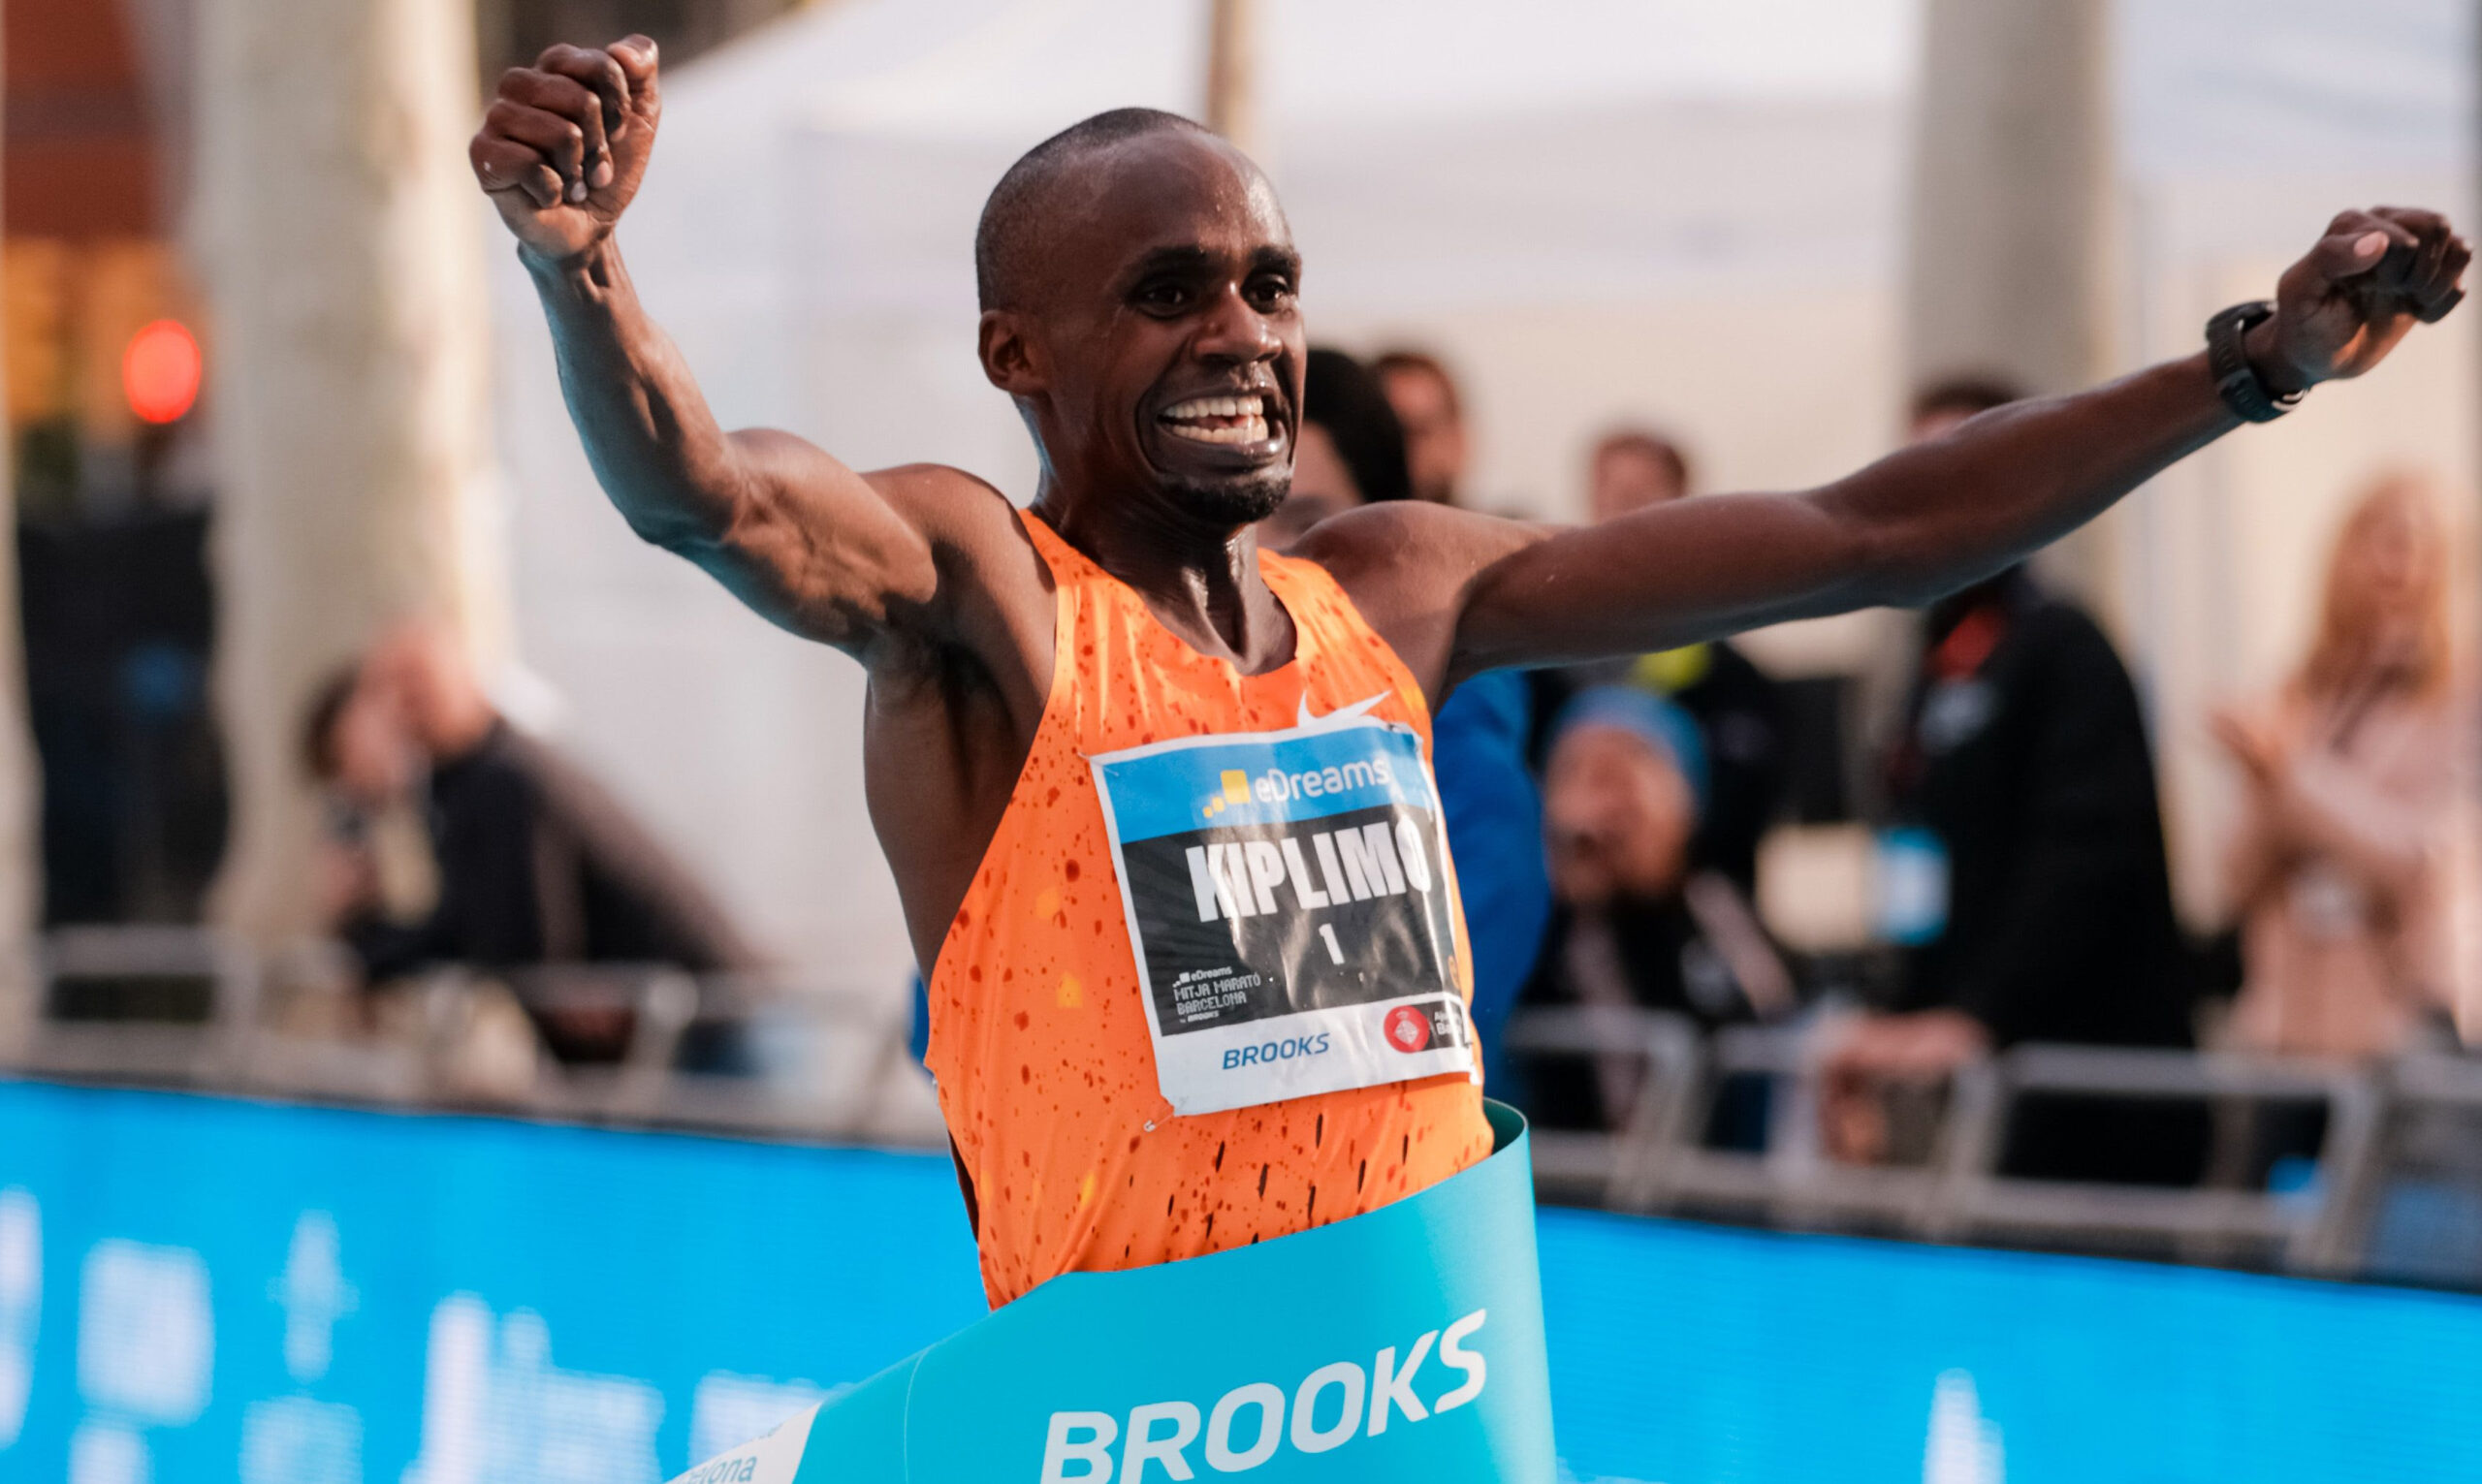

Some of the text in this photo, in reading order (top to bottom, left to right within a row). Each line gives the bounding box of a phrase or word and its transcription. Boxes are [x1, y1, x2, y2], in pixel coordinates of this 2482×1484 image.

[1255, 757, 1390, 804] eDreams
[1185, 814, 1432, 923] KIPLIMO
[1319, 923, 1345, 965] 1
[1173, 983, 1211, 1001] MITJA
[1191, 966, 1232, 981] eDreams
[1176, 991, 1247, 1016] BARCELONA
[1222, 1032, 1330, 1070] BROOKS
[1040, 1308, 1487, 1484] BROOKS
